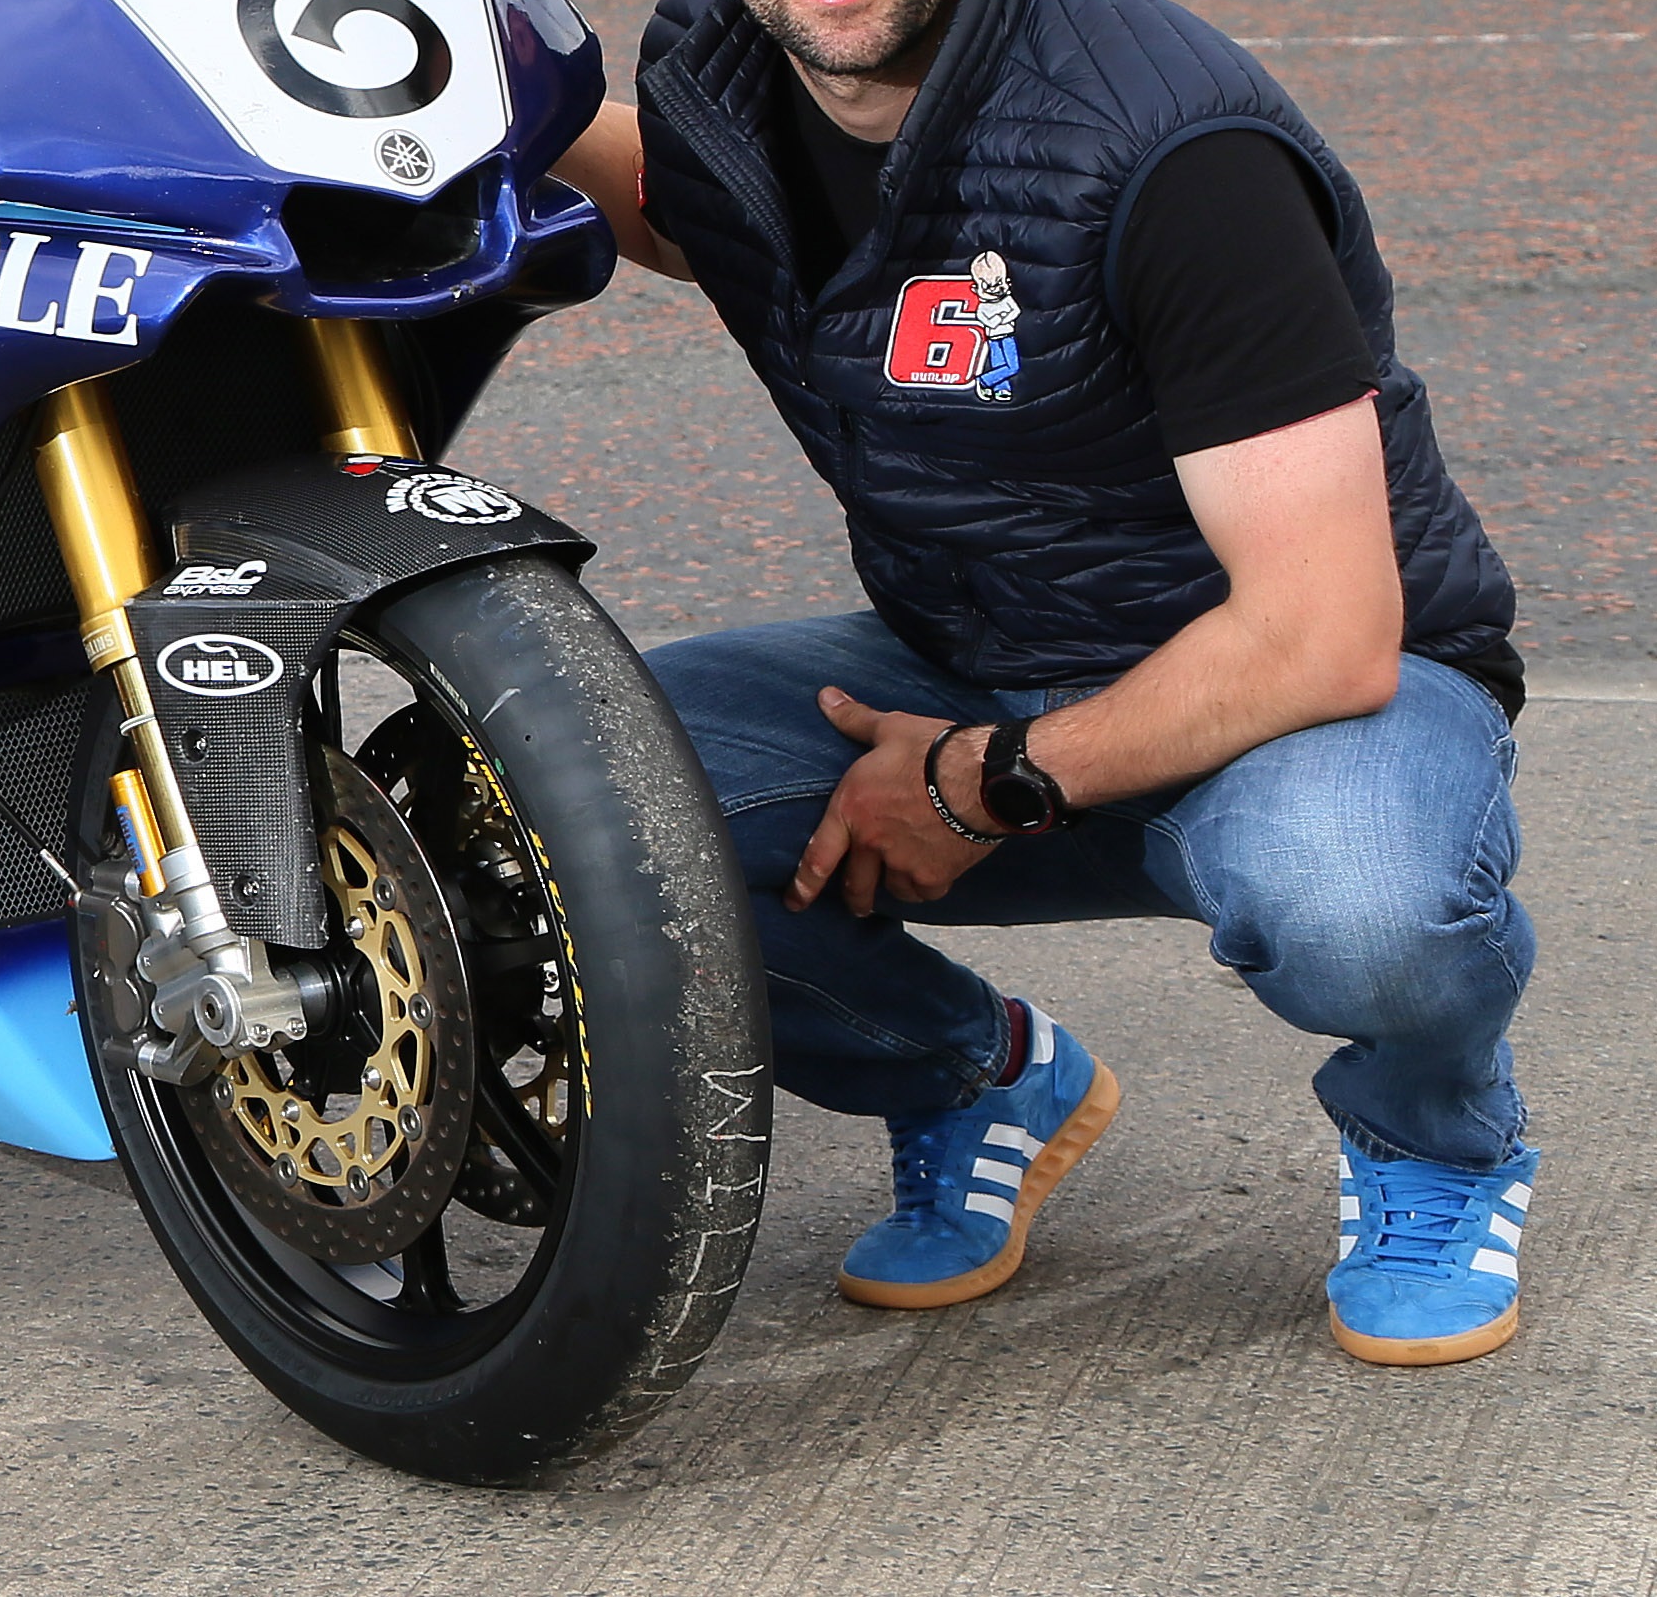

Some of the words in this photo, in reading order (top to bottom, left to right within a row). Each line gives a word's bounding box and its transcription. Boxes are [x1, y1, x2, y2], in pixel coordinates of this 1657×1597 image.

[884, 274, 987, 391] 6
[910, 371, 961, 384] DUNLOP
[161, 583, 254, 598] express
[84, 632, 116, 659] LINS
[181, 659, 261, 682] HEL
